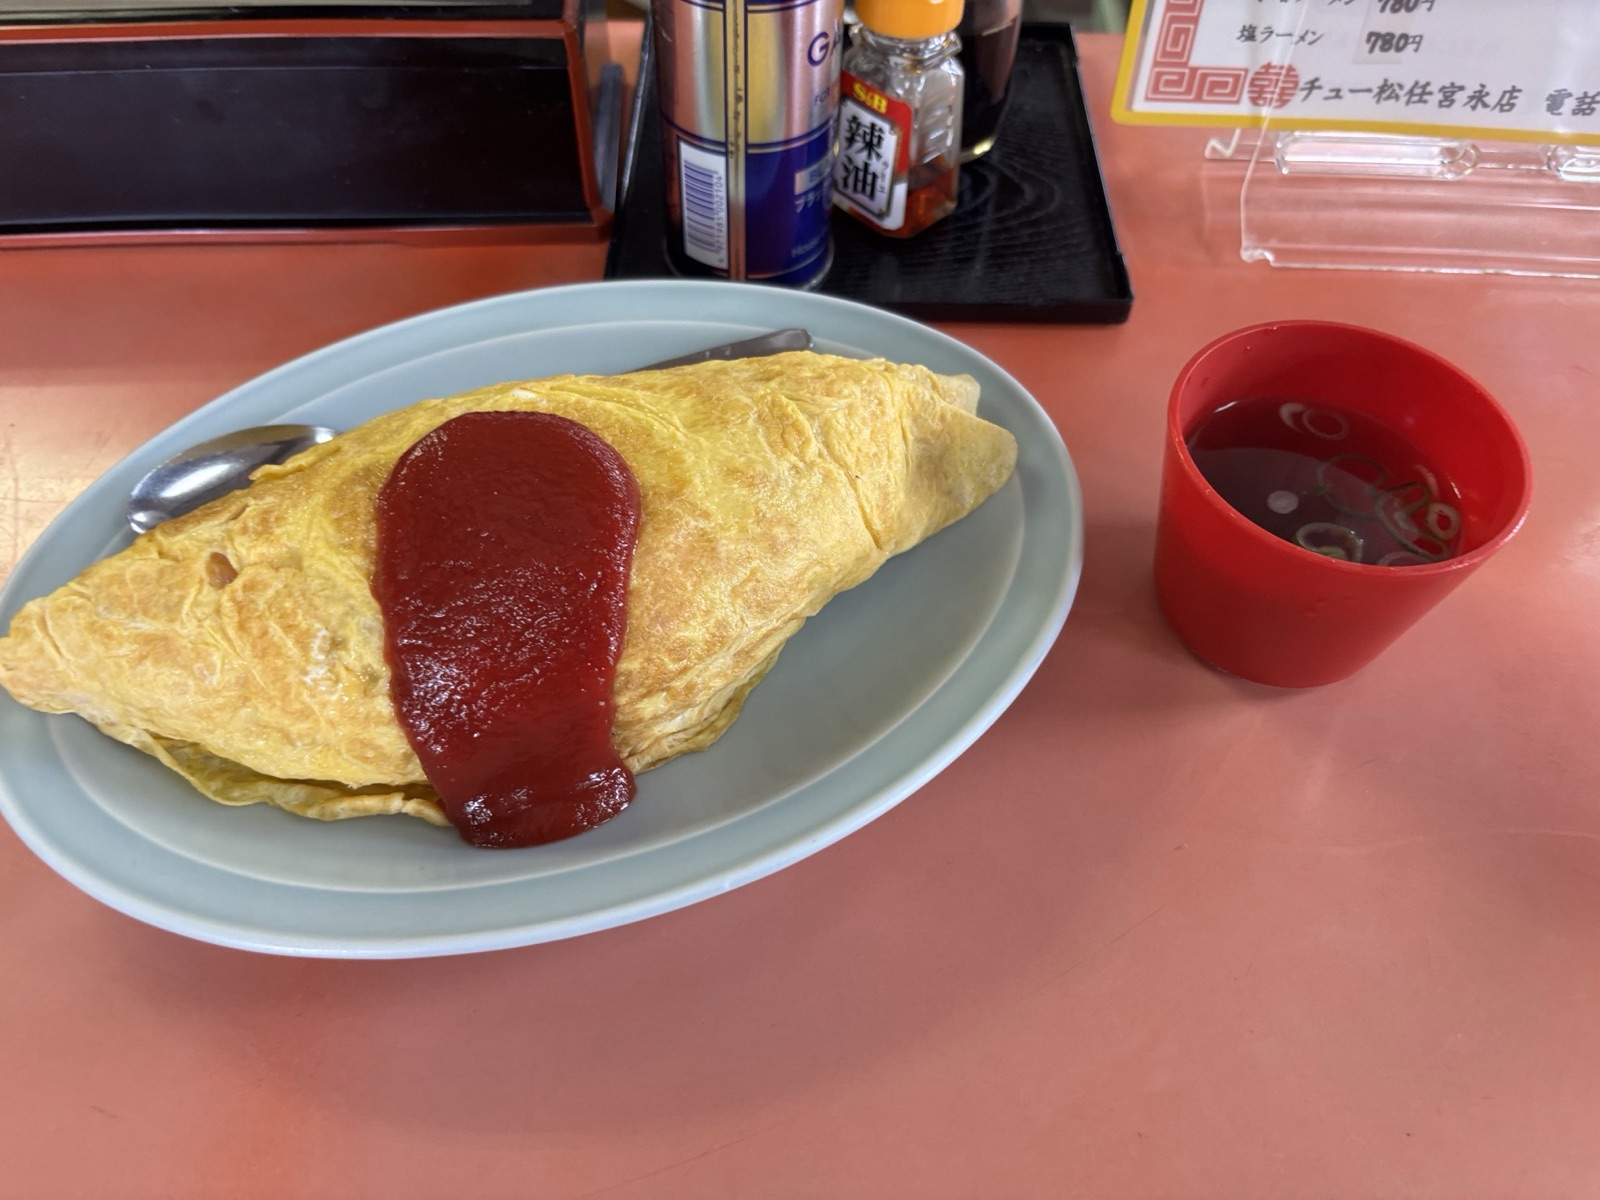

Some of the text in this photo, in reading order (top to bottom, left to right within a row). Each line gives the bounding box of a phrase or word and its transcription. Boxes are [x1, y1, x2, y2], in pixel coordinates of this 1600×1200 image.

[1236, 24, 1424, 55] 塩ラーメン 780円
[842, 115, 884, 202] 辣油
